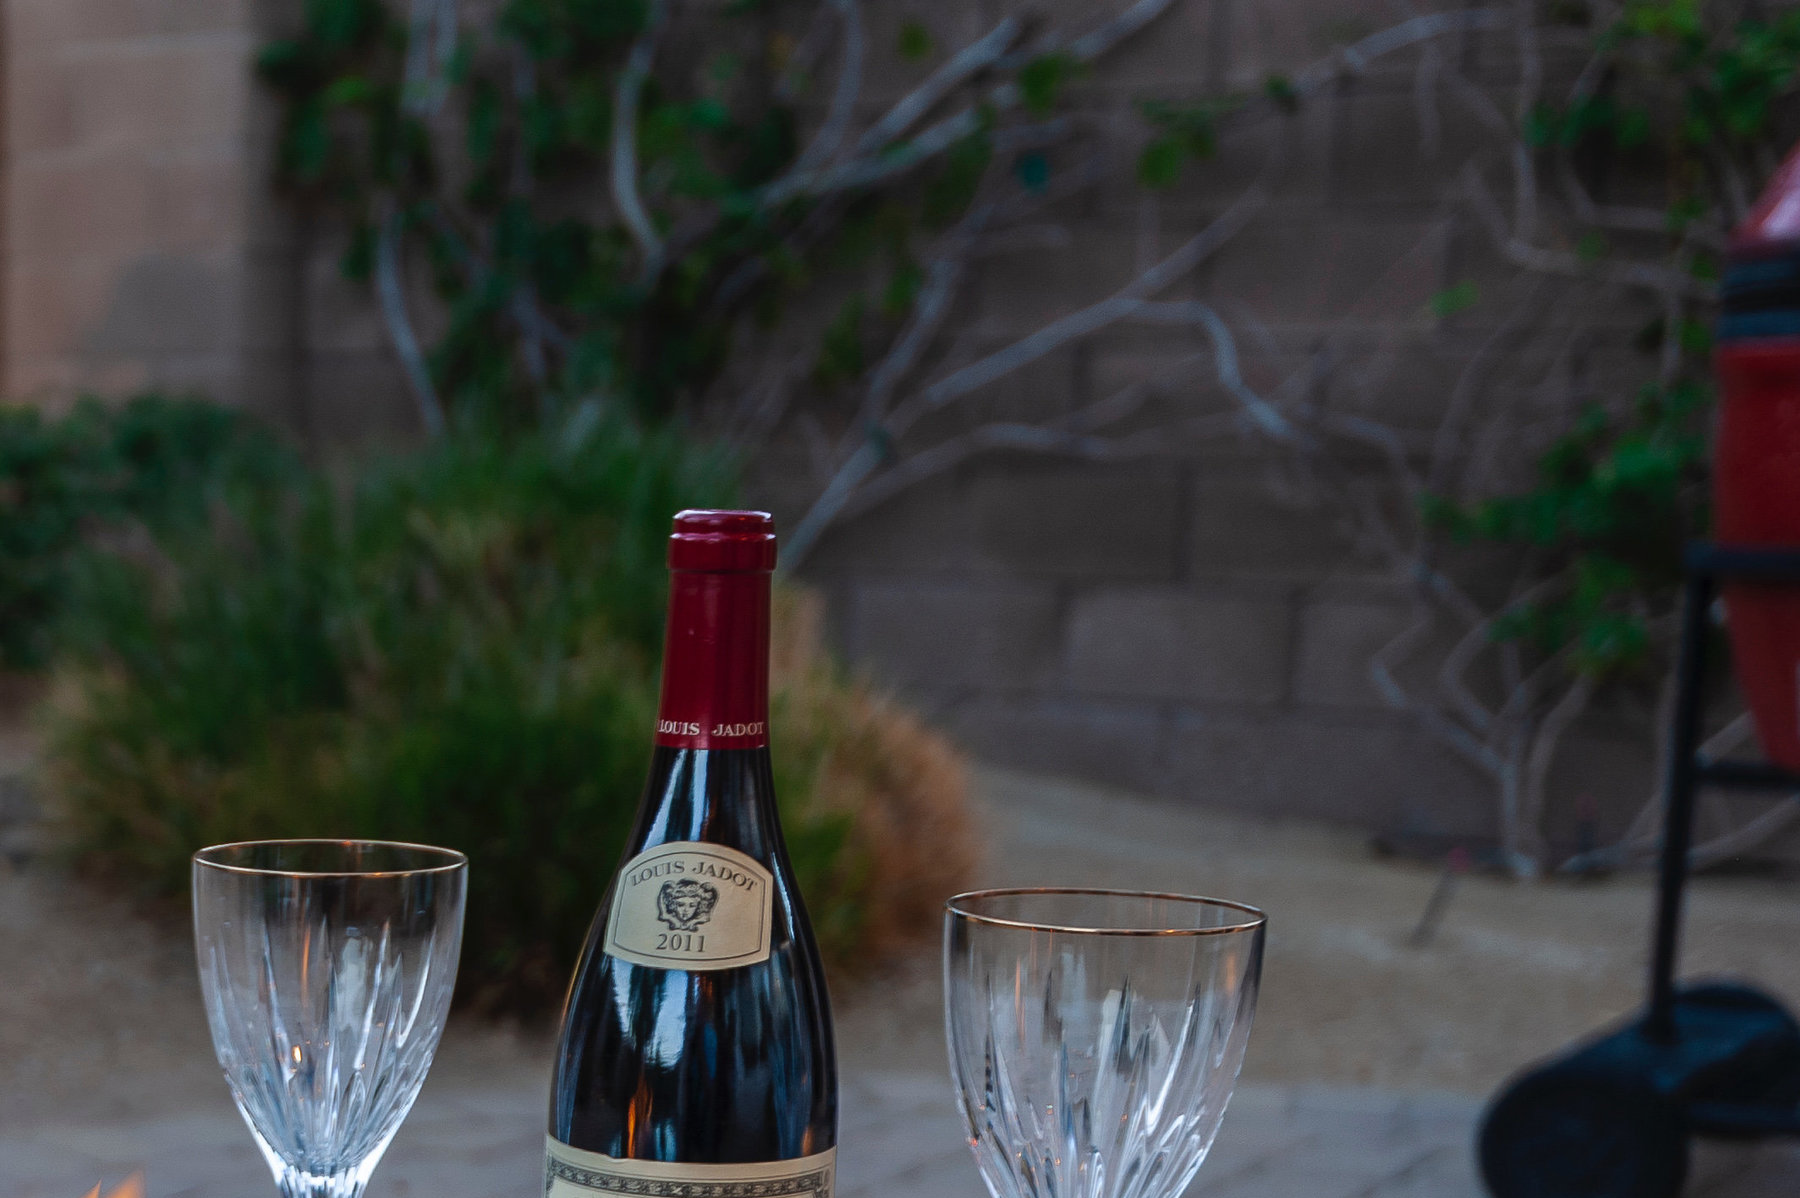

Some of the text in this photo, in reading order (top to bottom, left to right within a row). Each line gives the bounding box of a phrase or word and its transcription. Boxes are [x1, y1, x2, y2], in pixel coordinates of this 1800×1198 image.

[658, 719, 764, 737] LOUIS JADOT
[632, 861, 758, 891] LOUIS JADOT
[656, 933, 705, 953] 2011
